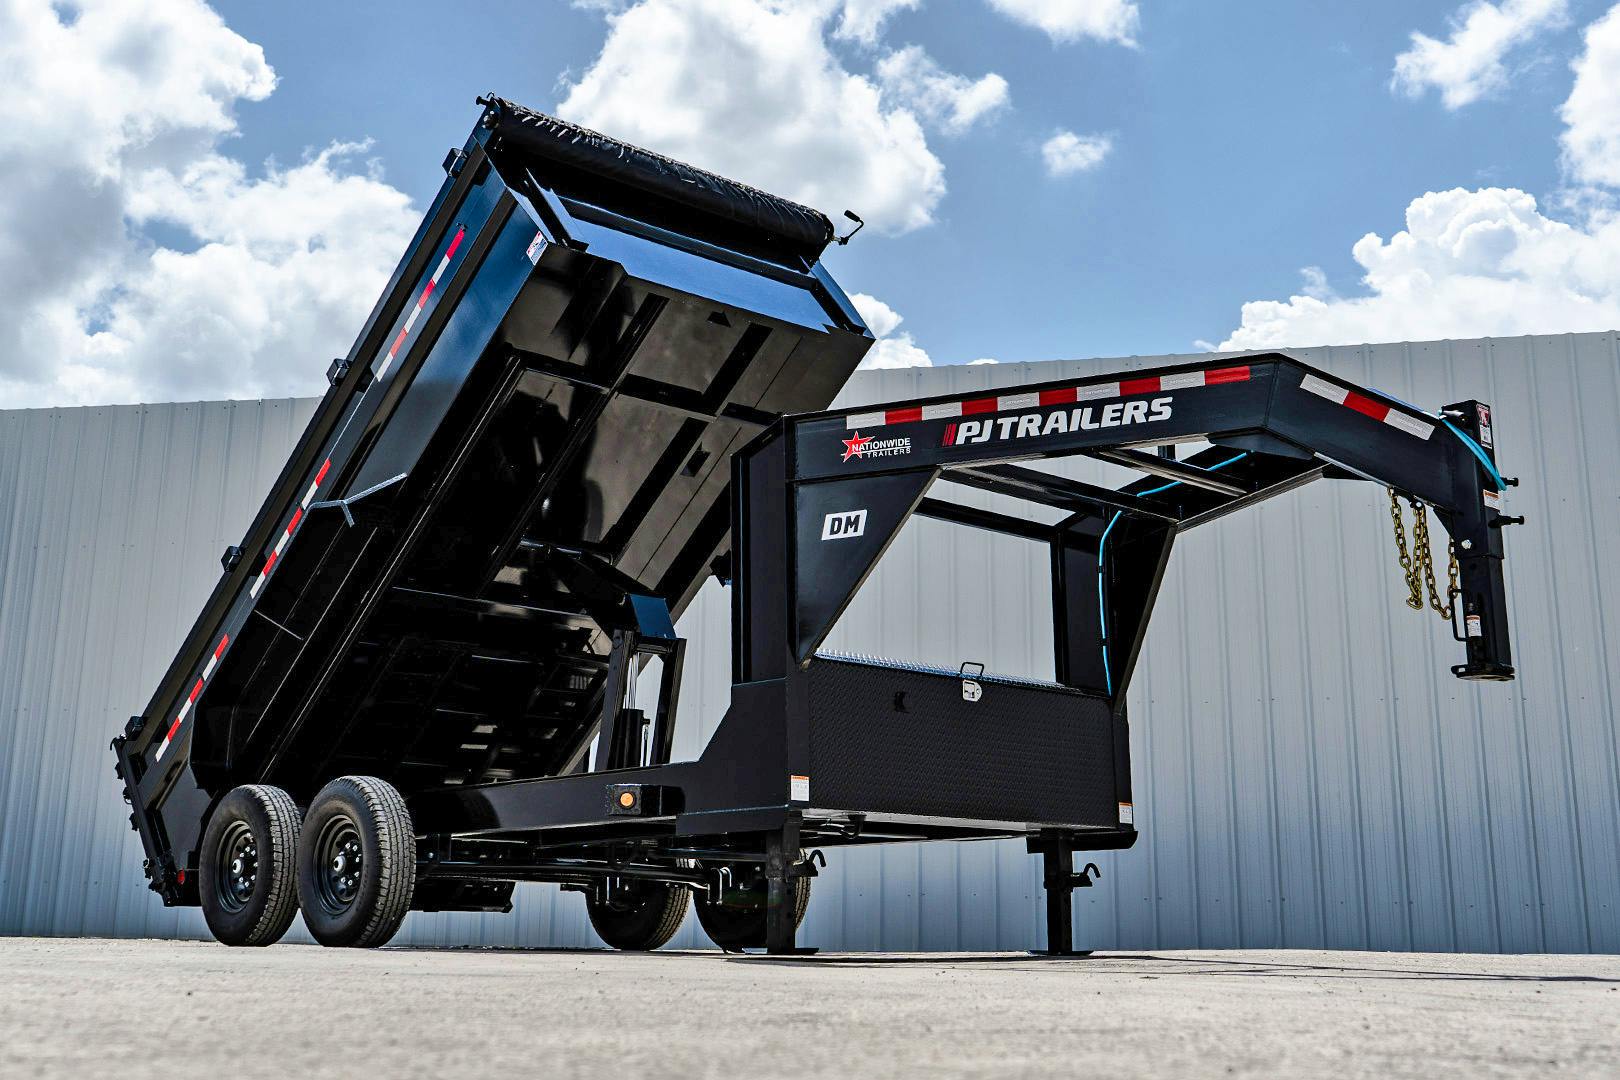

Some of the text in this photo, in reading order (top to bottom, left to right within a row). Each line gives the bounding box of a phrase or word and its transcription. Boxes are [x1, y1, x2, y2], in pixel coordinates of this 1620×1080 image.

[851, 437, 912, 452] NATIONWIDE
[867, 447, 912, 459] TRAILERS
[829, 514, 861, 536] DM
